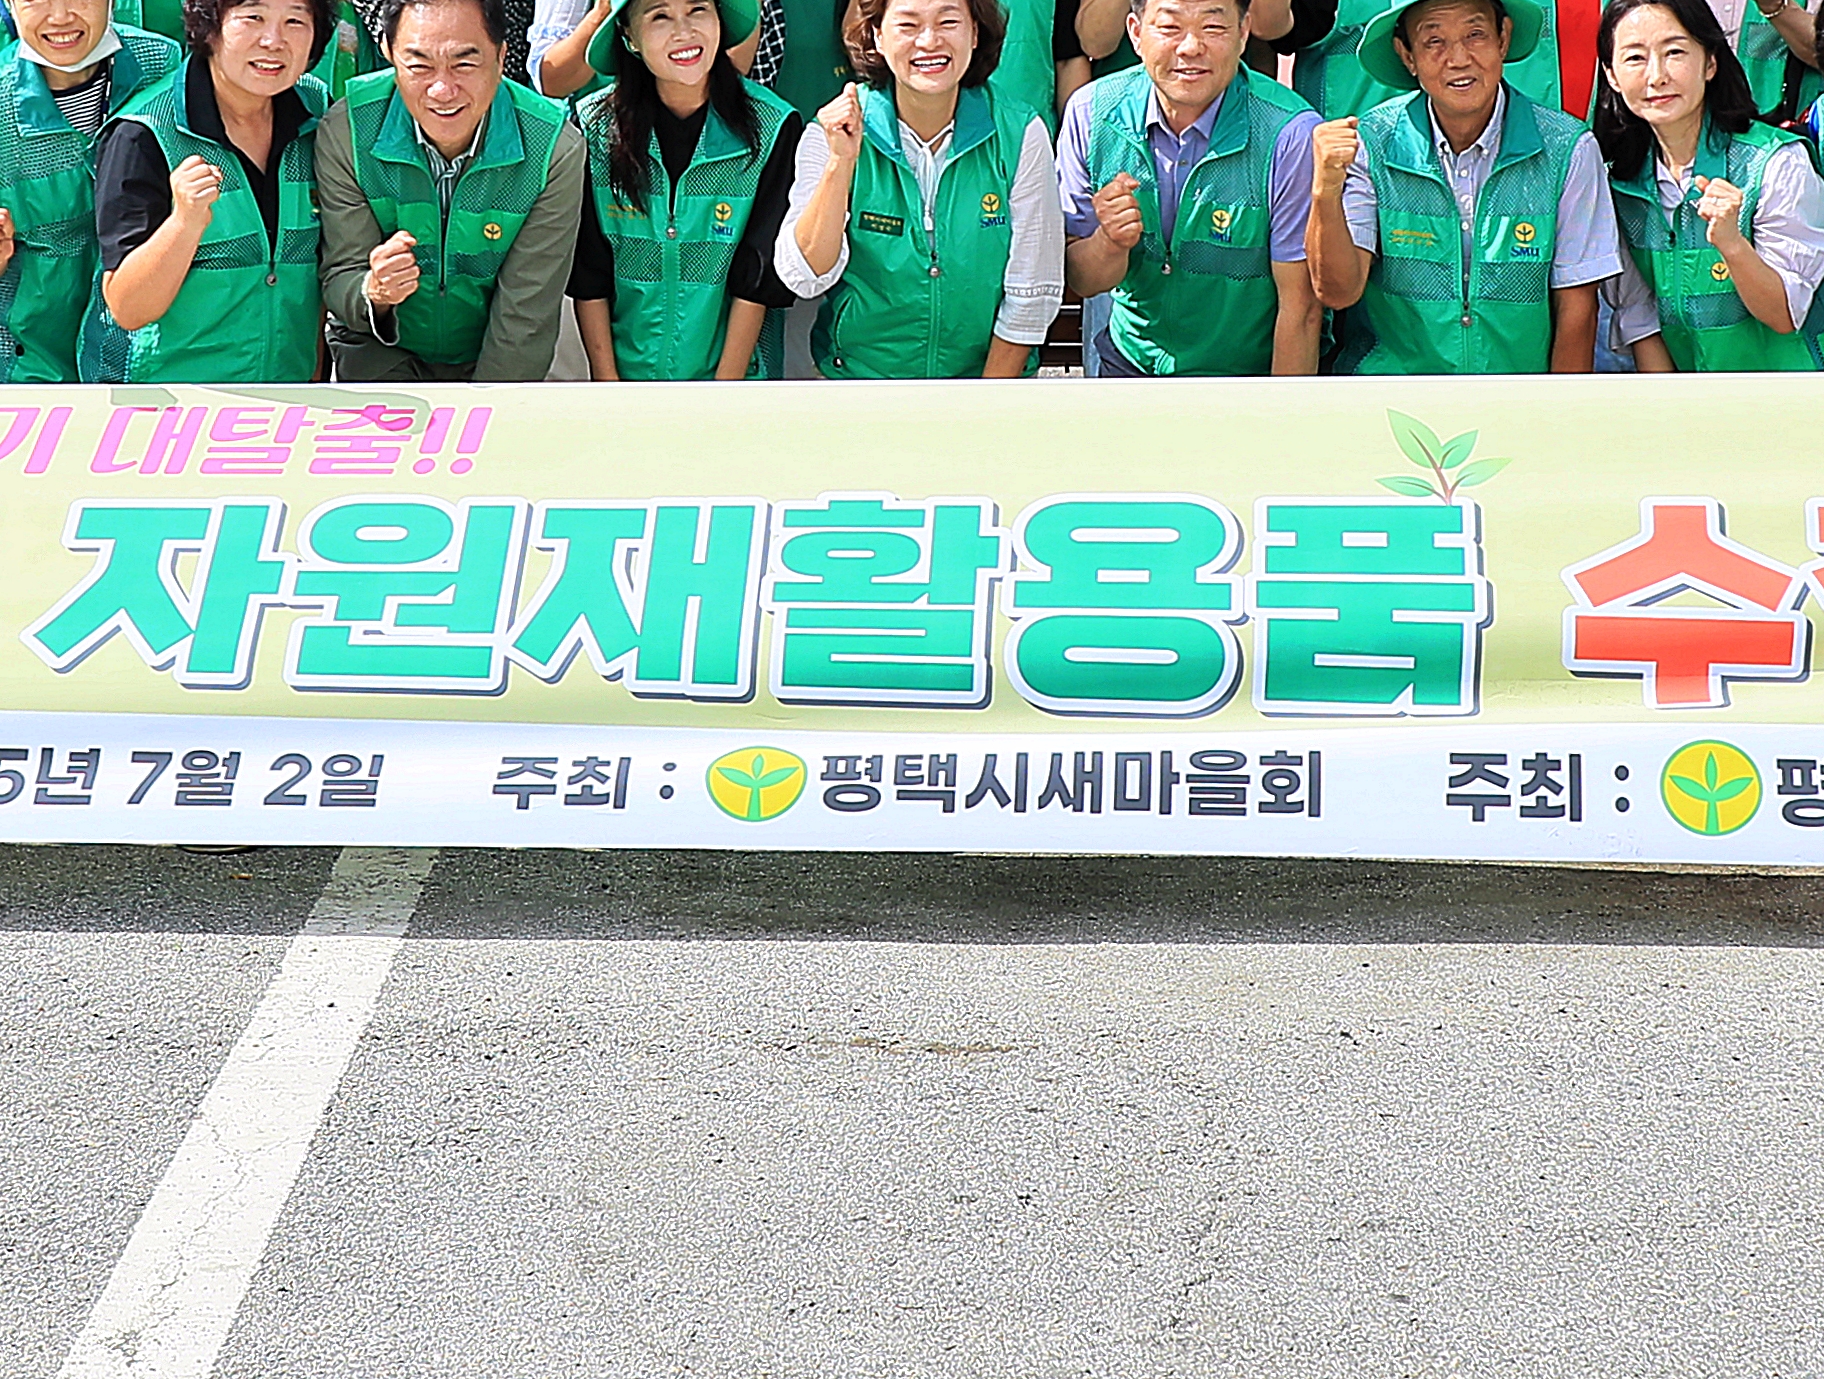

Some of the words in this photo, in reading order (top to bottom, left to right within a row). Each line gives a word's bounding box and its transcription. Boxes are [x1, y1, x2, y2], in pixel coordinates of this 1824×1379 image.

[980, 215, 1006, 228] SMU
[1511, 246, 1539, 258] SMU
[90, 404, 492, 475] 대탈출!!
[33, 498, 1482, 712] 자원재활용품
[126, 749, 242, 808] 7월
[263, 752, 385, 808] 2일
[491, 755, 631, 810] 주최
[819, 749, 1323, 819] 평택시새마을회
[1445, 751, 1582, 822] 주최
